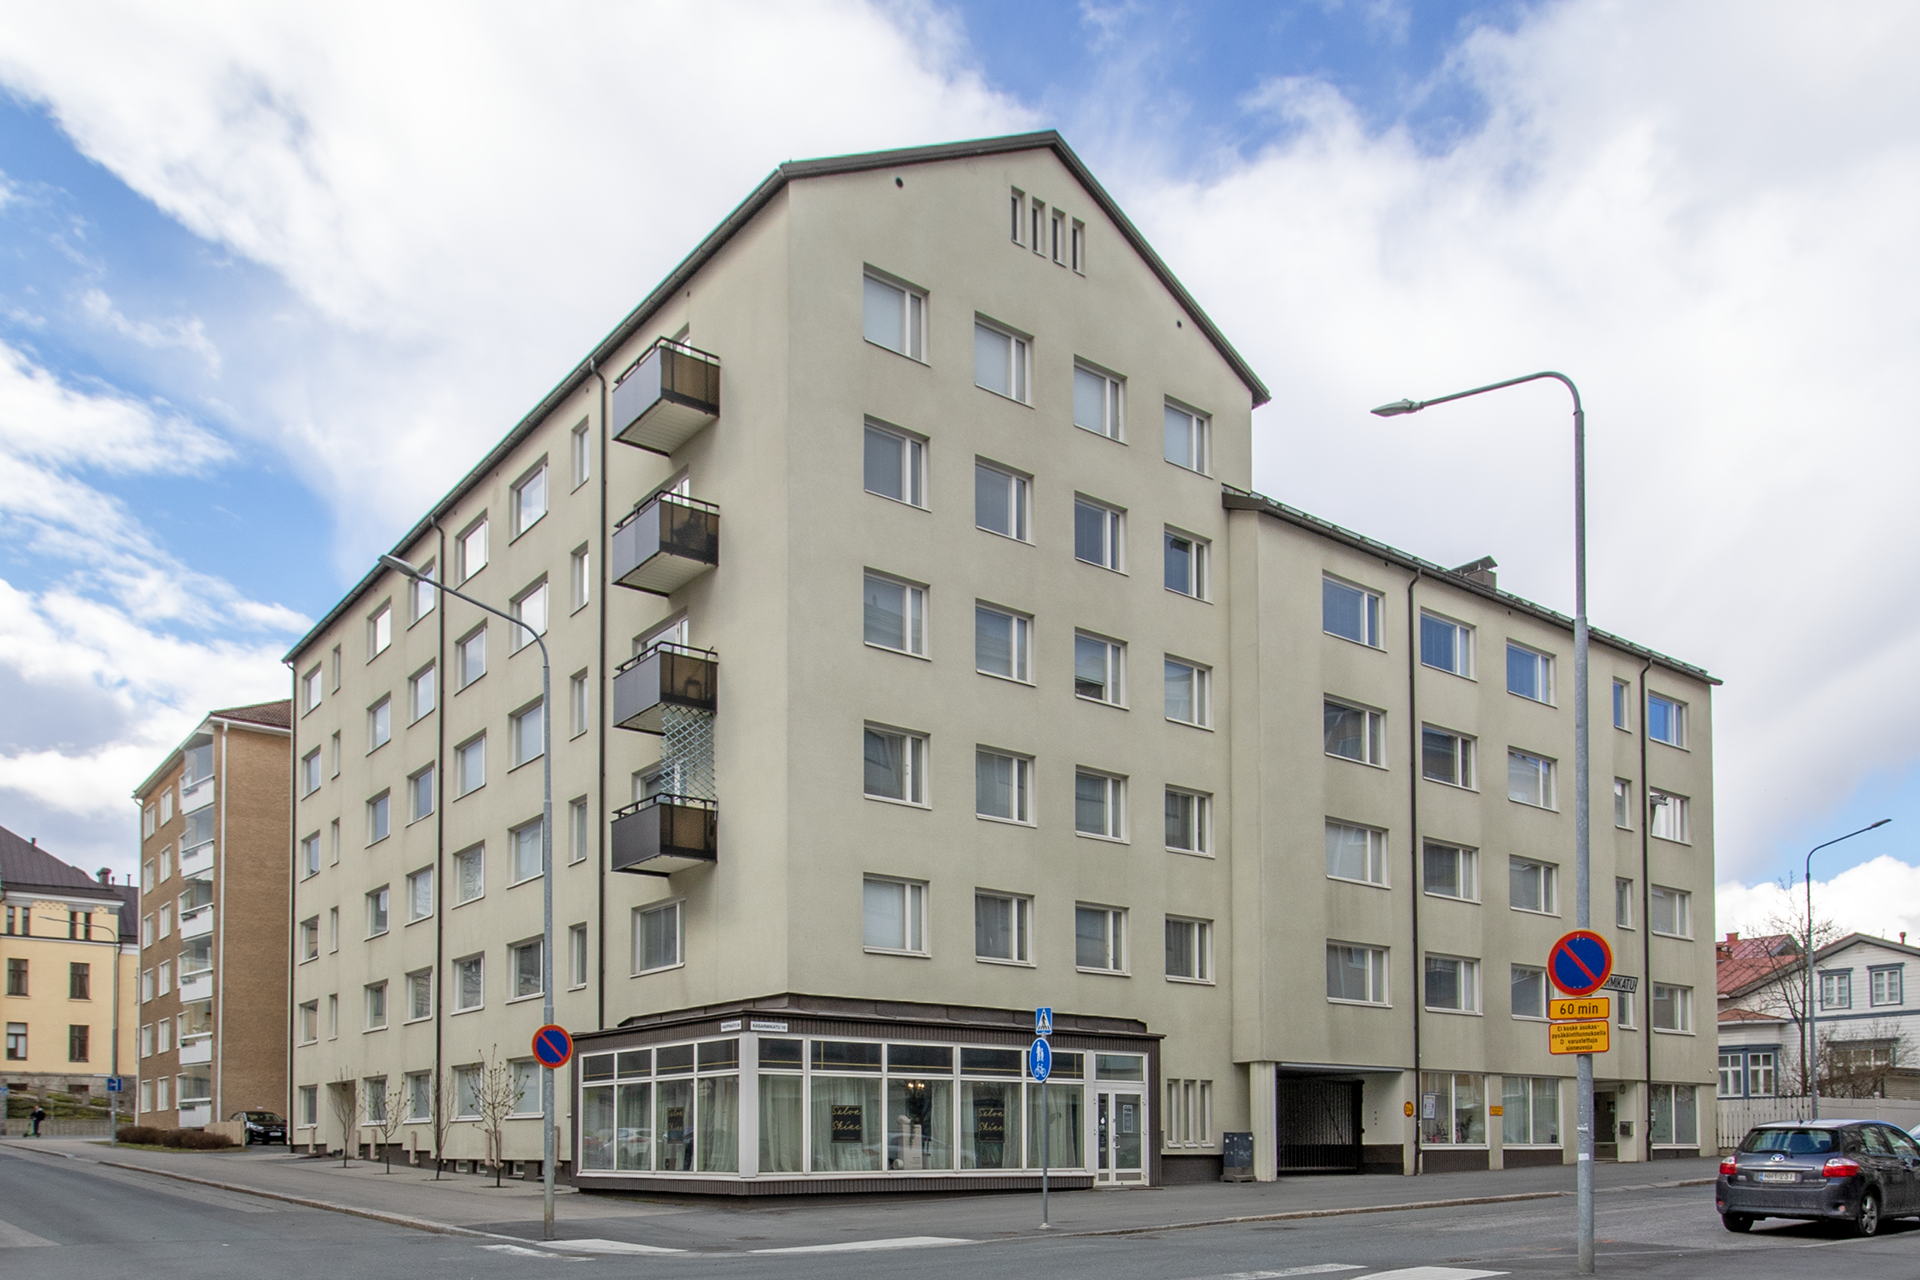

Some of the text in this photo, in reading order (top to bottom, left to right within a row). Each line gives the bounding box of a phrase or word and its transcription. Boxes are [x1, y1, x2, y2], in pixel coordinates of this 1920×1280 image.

[1560, 1003, 1598, 1015] 60 min
[832, 1106, 861, 1115] Salon
